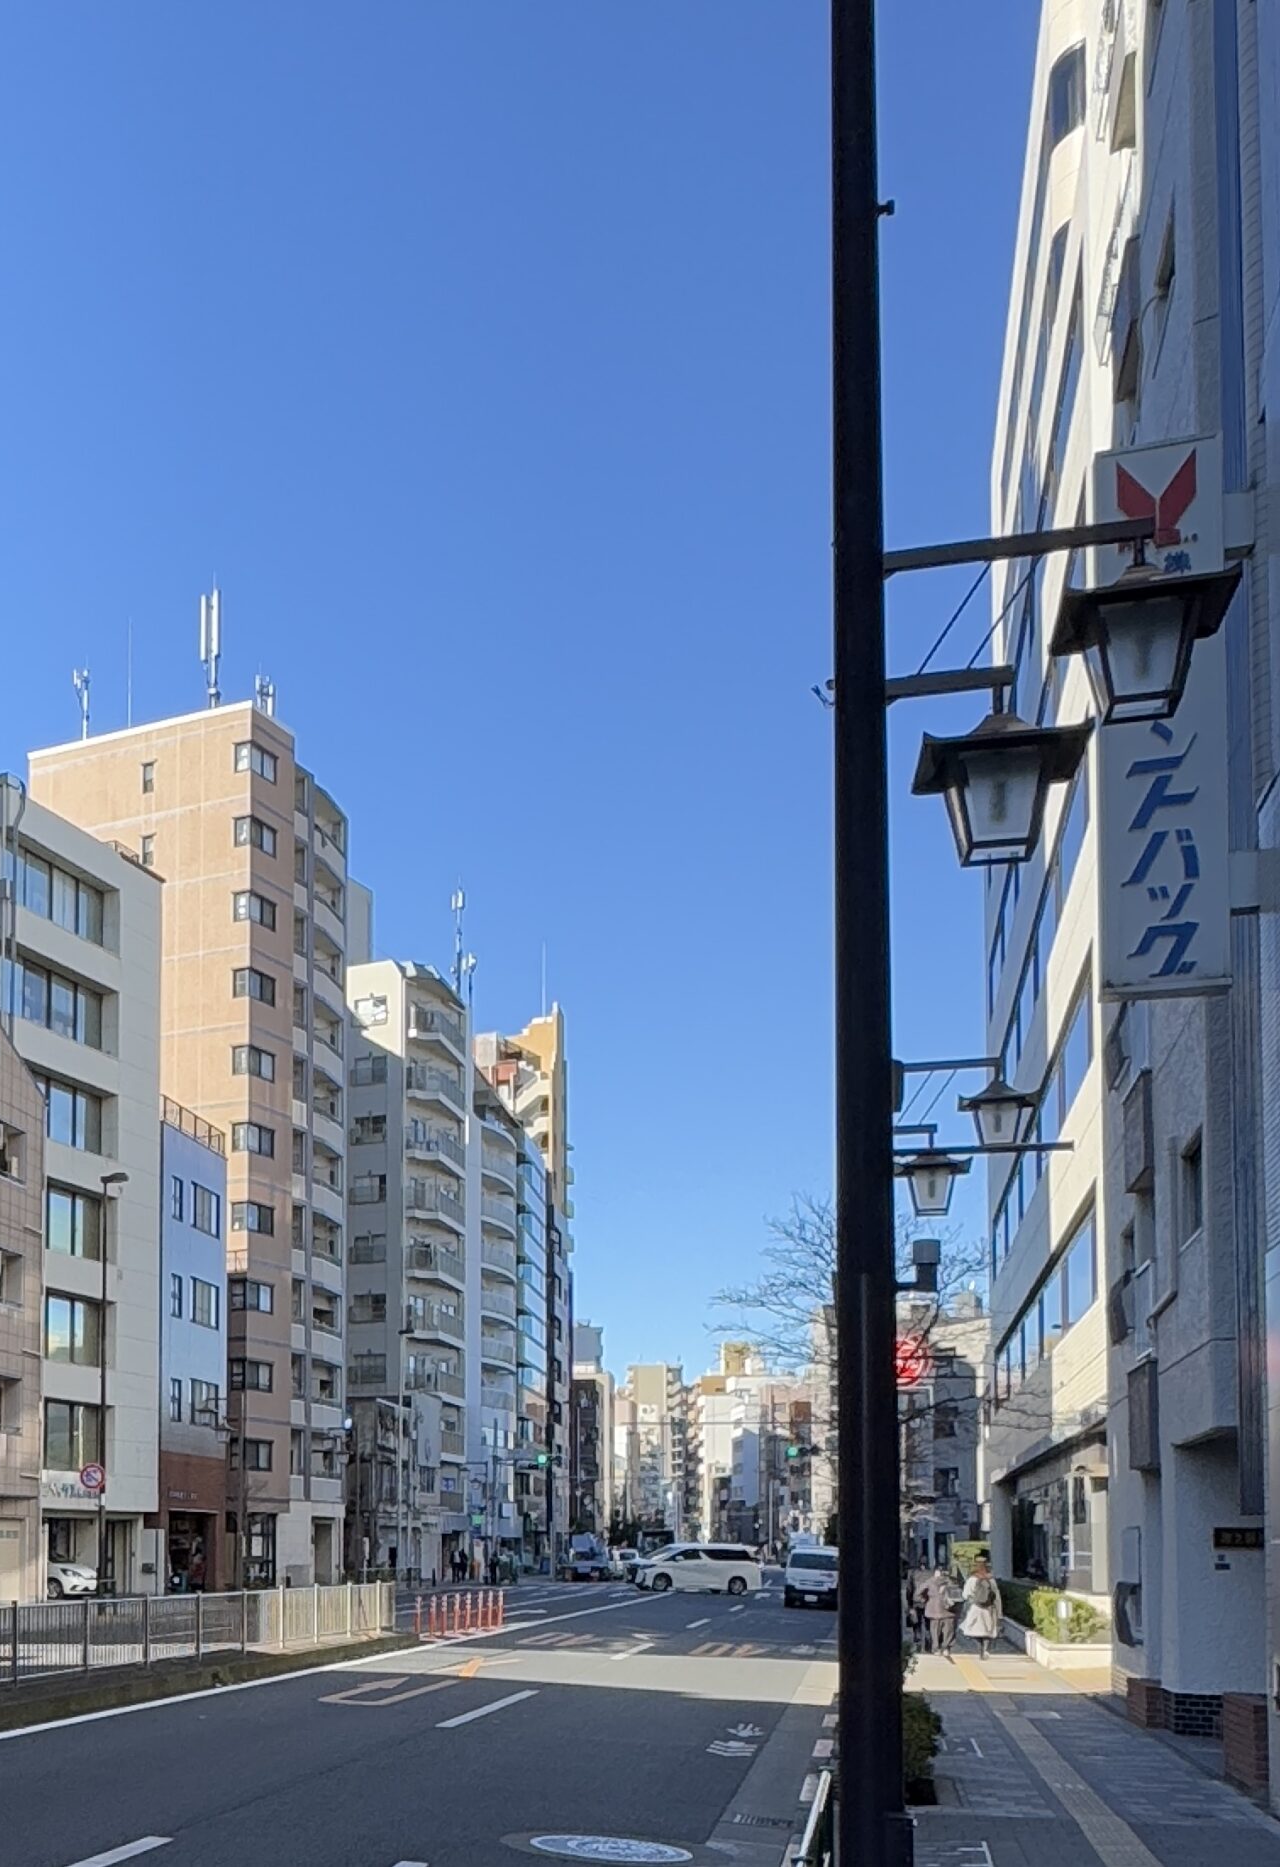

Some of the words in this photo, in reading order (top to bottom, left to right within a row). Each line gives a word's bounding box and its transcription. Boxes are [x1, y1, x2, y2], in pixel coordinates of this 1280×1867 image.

[1120, 719, 1200, 979] ントバッグ
